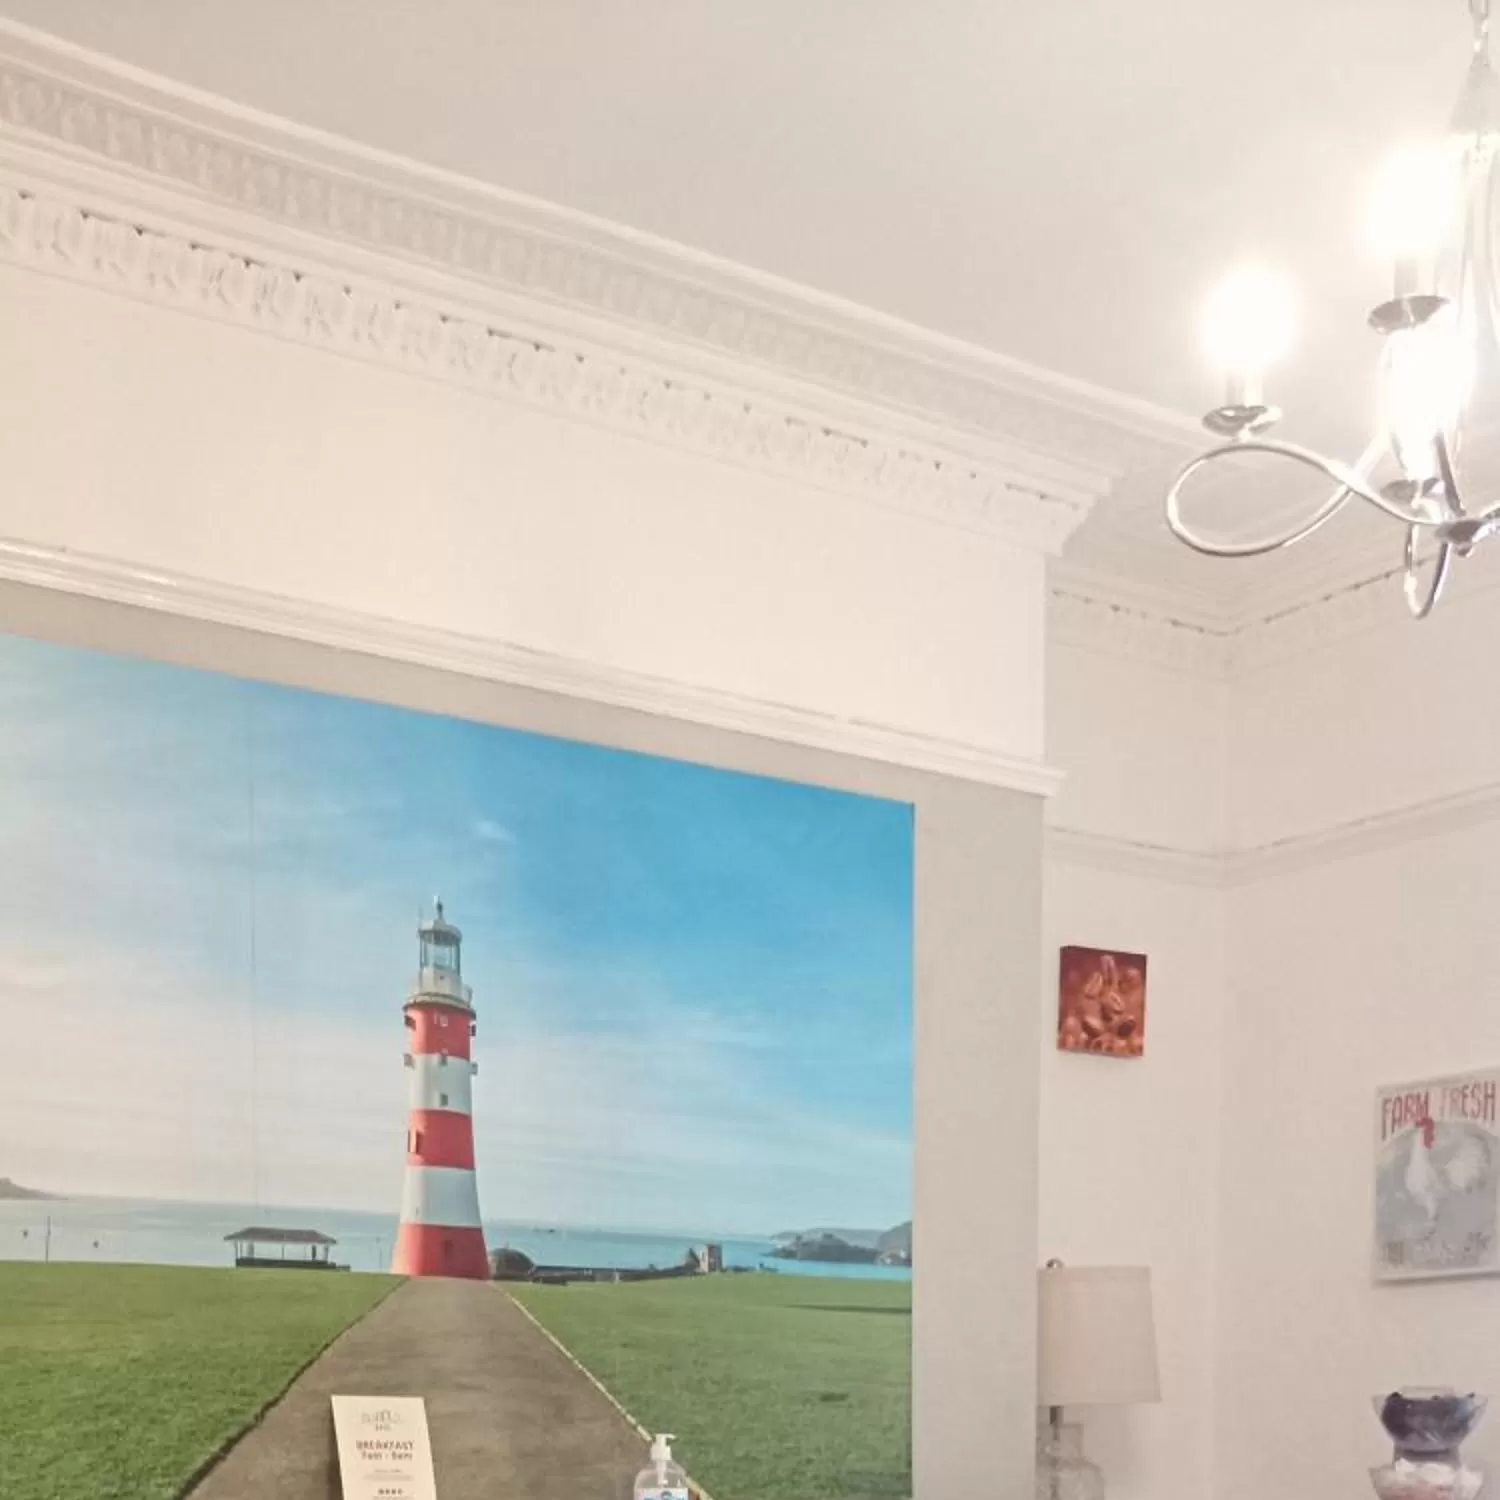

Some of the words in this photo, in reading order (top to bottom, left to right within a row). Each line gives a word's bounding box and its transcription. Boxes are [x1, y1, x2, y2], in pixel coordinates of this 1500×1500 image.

[1381, 1091, 1430, 1141] FARM
[1440, 1080, 1496, 1122] FRESH
[356, 1440, 414, 1450] BREAKFAST
